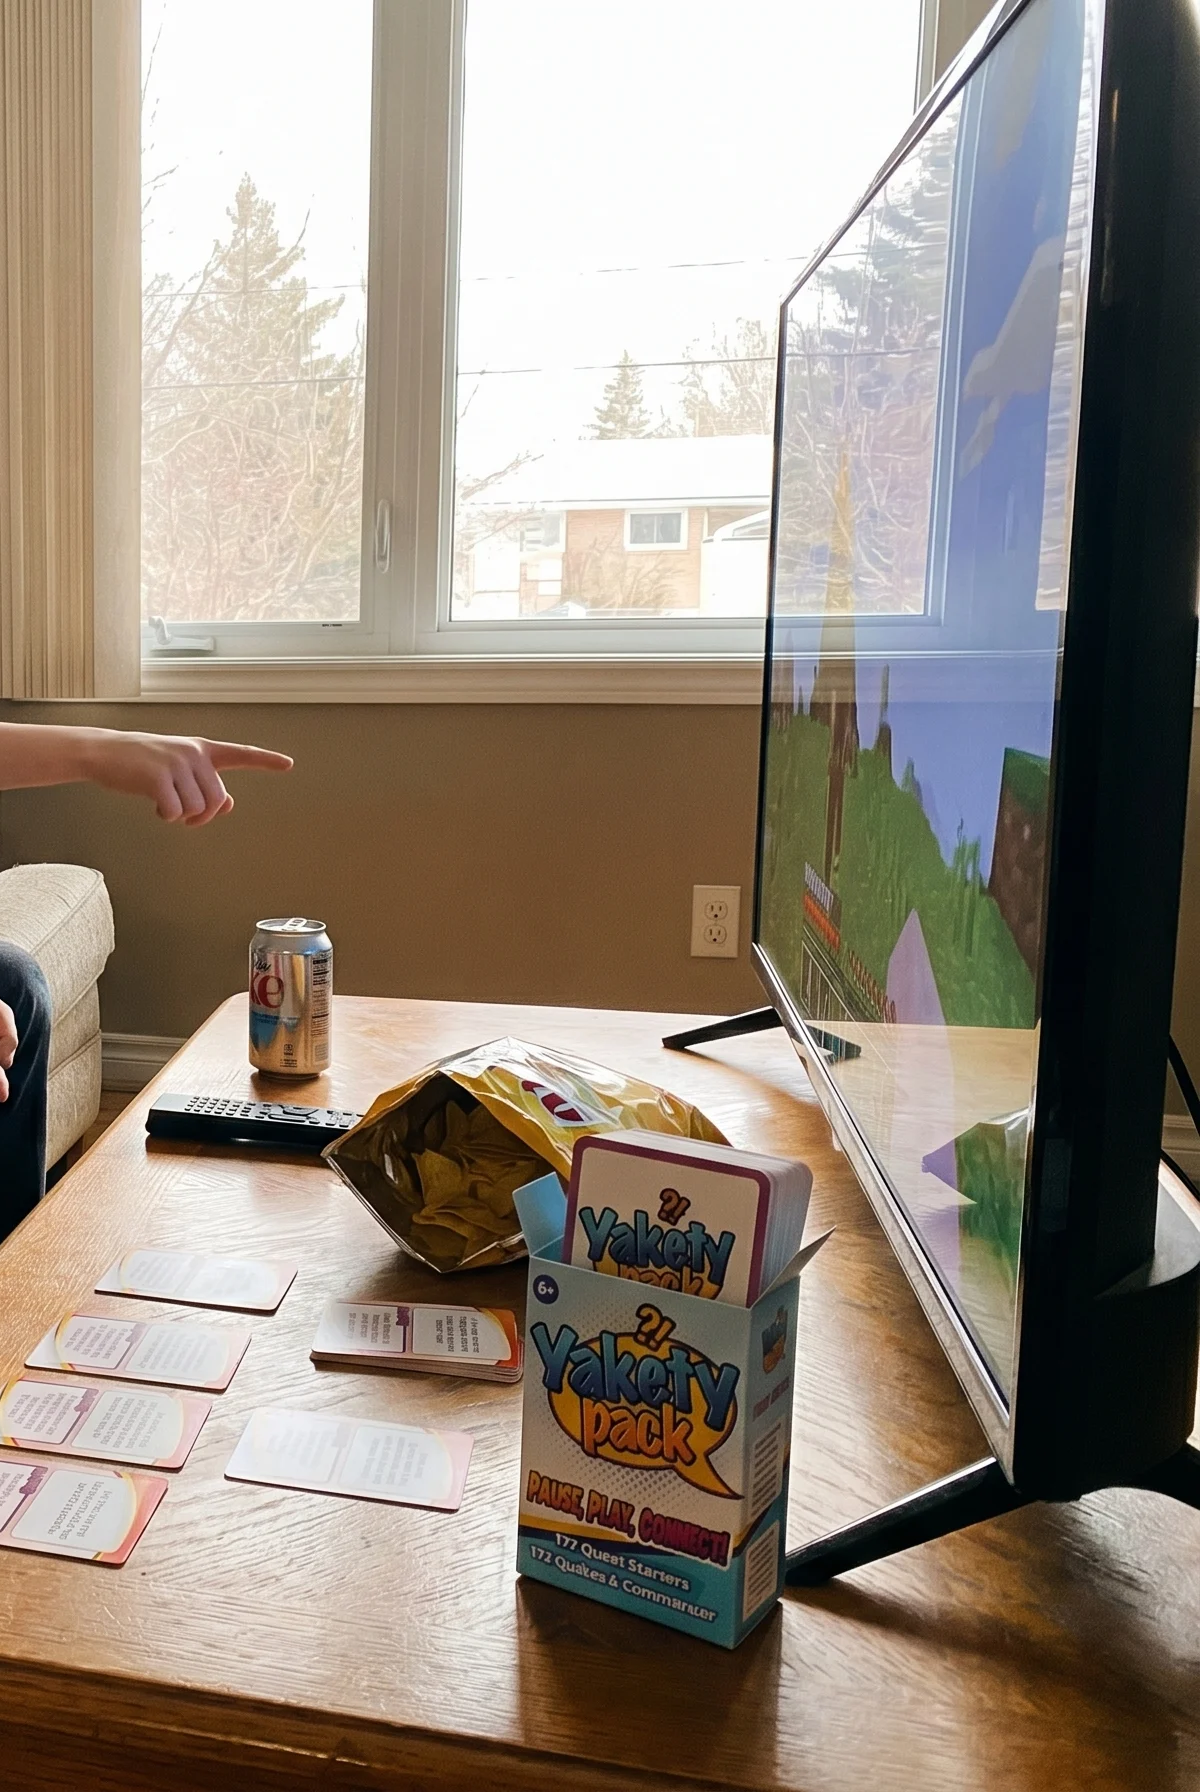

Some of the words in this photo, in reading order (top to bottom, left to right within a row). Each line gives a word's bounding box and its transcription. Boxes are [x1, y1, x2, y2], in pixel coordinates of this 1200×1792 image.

[579, 1206, 736, 1286] Yakety
[537, 1281, 555, 1296] 6+
[530, 1322, 740, 1431] Yakety
[581, 1396, 696, 1466] pack
[526, 1470, 584, 1521] PAUSE,
[585, 1489, 635, 1538] PLAY,
[608, 1574, 619, 1588] &
[628, 1559, 690, 1591] Starters
